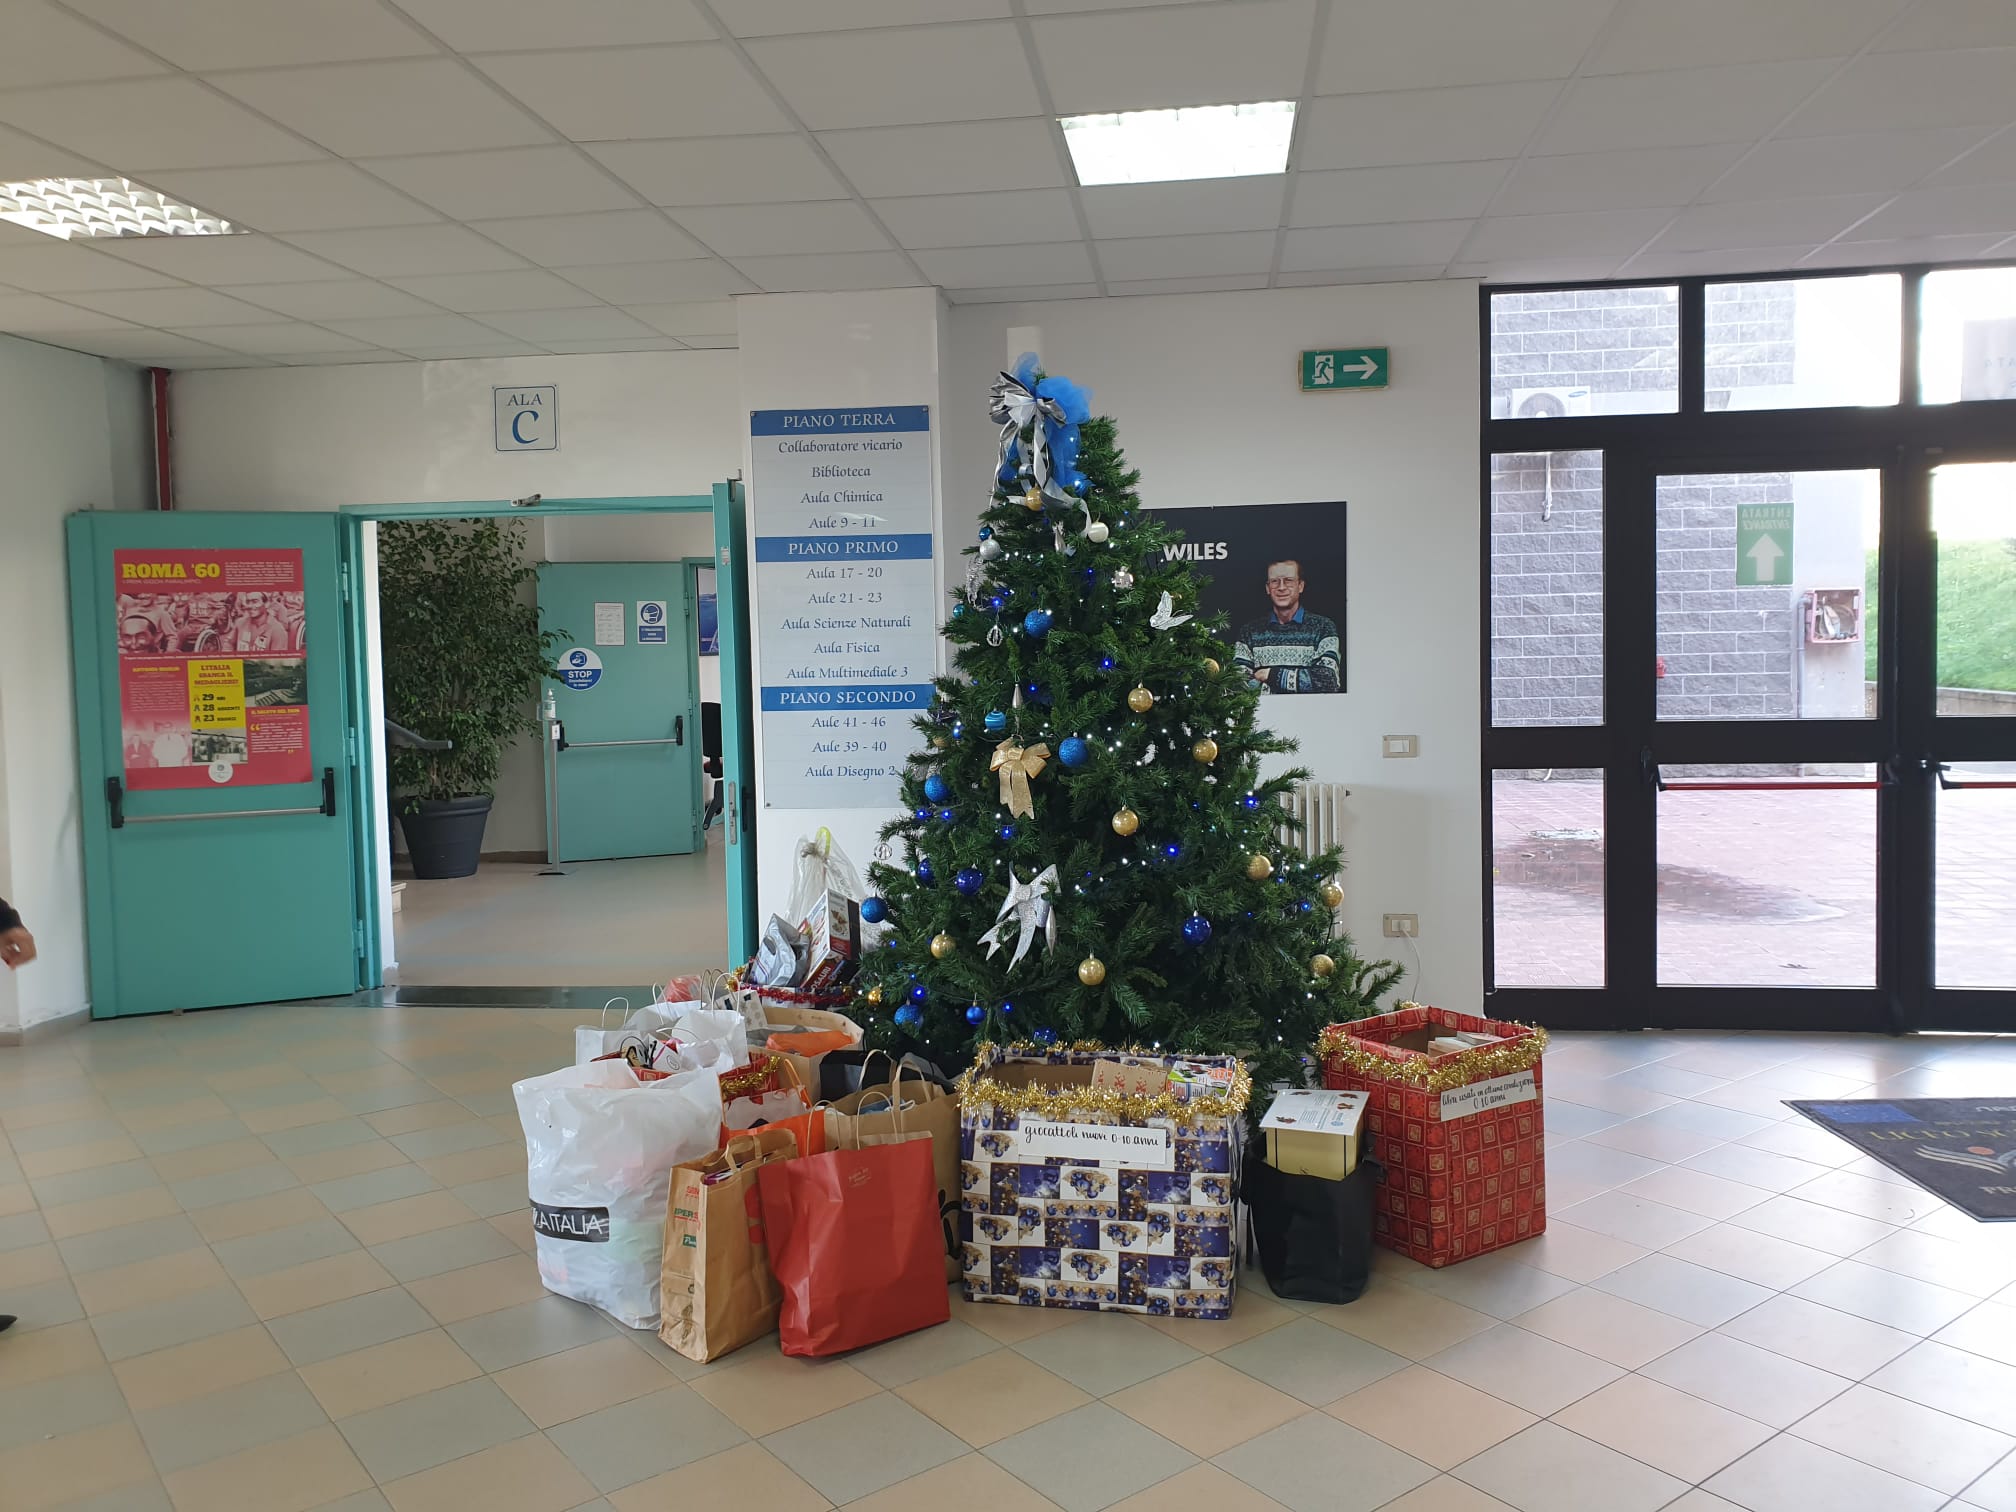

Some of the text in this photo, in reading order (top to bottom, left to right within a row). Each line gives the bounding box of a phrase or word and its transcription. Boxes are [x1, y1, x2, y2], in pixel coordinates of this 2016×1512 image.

[506, 393, 542, 406] ALA
[512, 410, 540, 444] C
[784, 413, 896, 428] PIANO TERRA
[778, 439, 903, 454] Collaboratore vicario
[811, 465, 871, 478] Biblioteca
[800, 490, 884, 504] Aula Chimica
[808, 516, 837, 529] Aule
[840, 516, 848, 528] 9
[788, 541, 899, 555] PIANO PRIMO
[1163, 542, 1228, 561] WILES
[122, 563, 187, 578] ROMA
[806, 567, 835, 579] Aula
[840, 567, 854, 579] 17
[867, 567, 883, 578] 20
[808, 592, 836, 604] Aule
[839, 592, 854, 604] 21
[867, 592, 882, 603] 23
[780, 615, 911, 630] Aula Scienze Naturali
[813, 641, 880, 654] Aula Fisica
[568, 670, 592, 678] STOP
[786, 666, 908, 679] Aula Multimediale 3
[202, 693, 215, 701] 29
[780, 690, 916, 705] PIANO SECONDO
[811, 716, 840, 728] Aule
[843, 716, 857, 728] 41
[871, 716, 886, 727] 46
[811, 741, 840, 753] Aule
[844, 741, 859, 752] 39
[871, 741, 887, 752] 40
[805, 765, 896, 781] Aula Disegno 2
[1025, 1125, 1079, 1144] giocattoli
[1082, 1131, 1108, 1141] nuovi
[1133, 1135, 1159, 1146] anni
